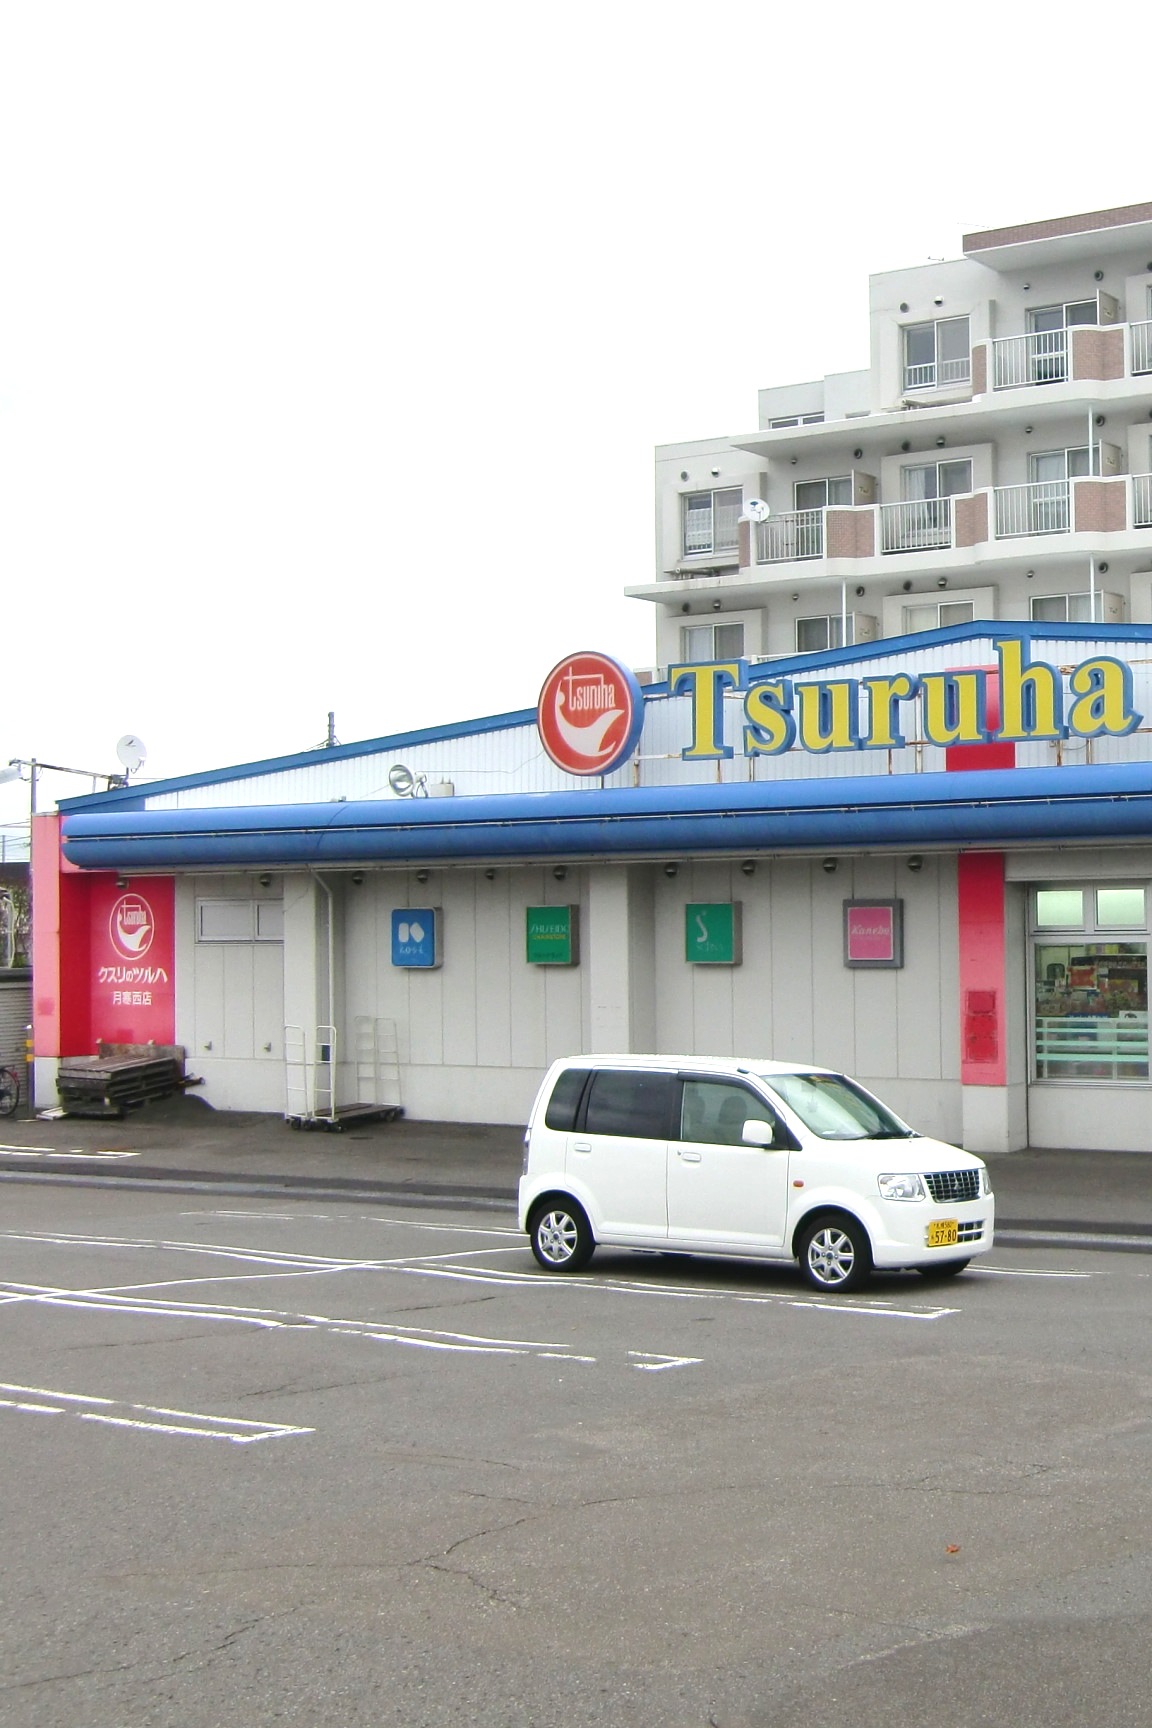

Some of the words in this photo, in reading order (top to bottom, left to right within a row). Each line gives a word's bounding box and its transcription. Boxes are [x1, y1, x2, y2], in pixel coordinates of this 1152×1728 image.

[563, 665, 616, 711] tsuruha
[668, 634, 1143, 761] Tsuruha
[98, 966, 168, 984] クスリのツルハ
[113, 990, 152, 1006] 月寒西店
[935, 1229, 957, 1244] 57-80
